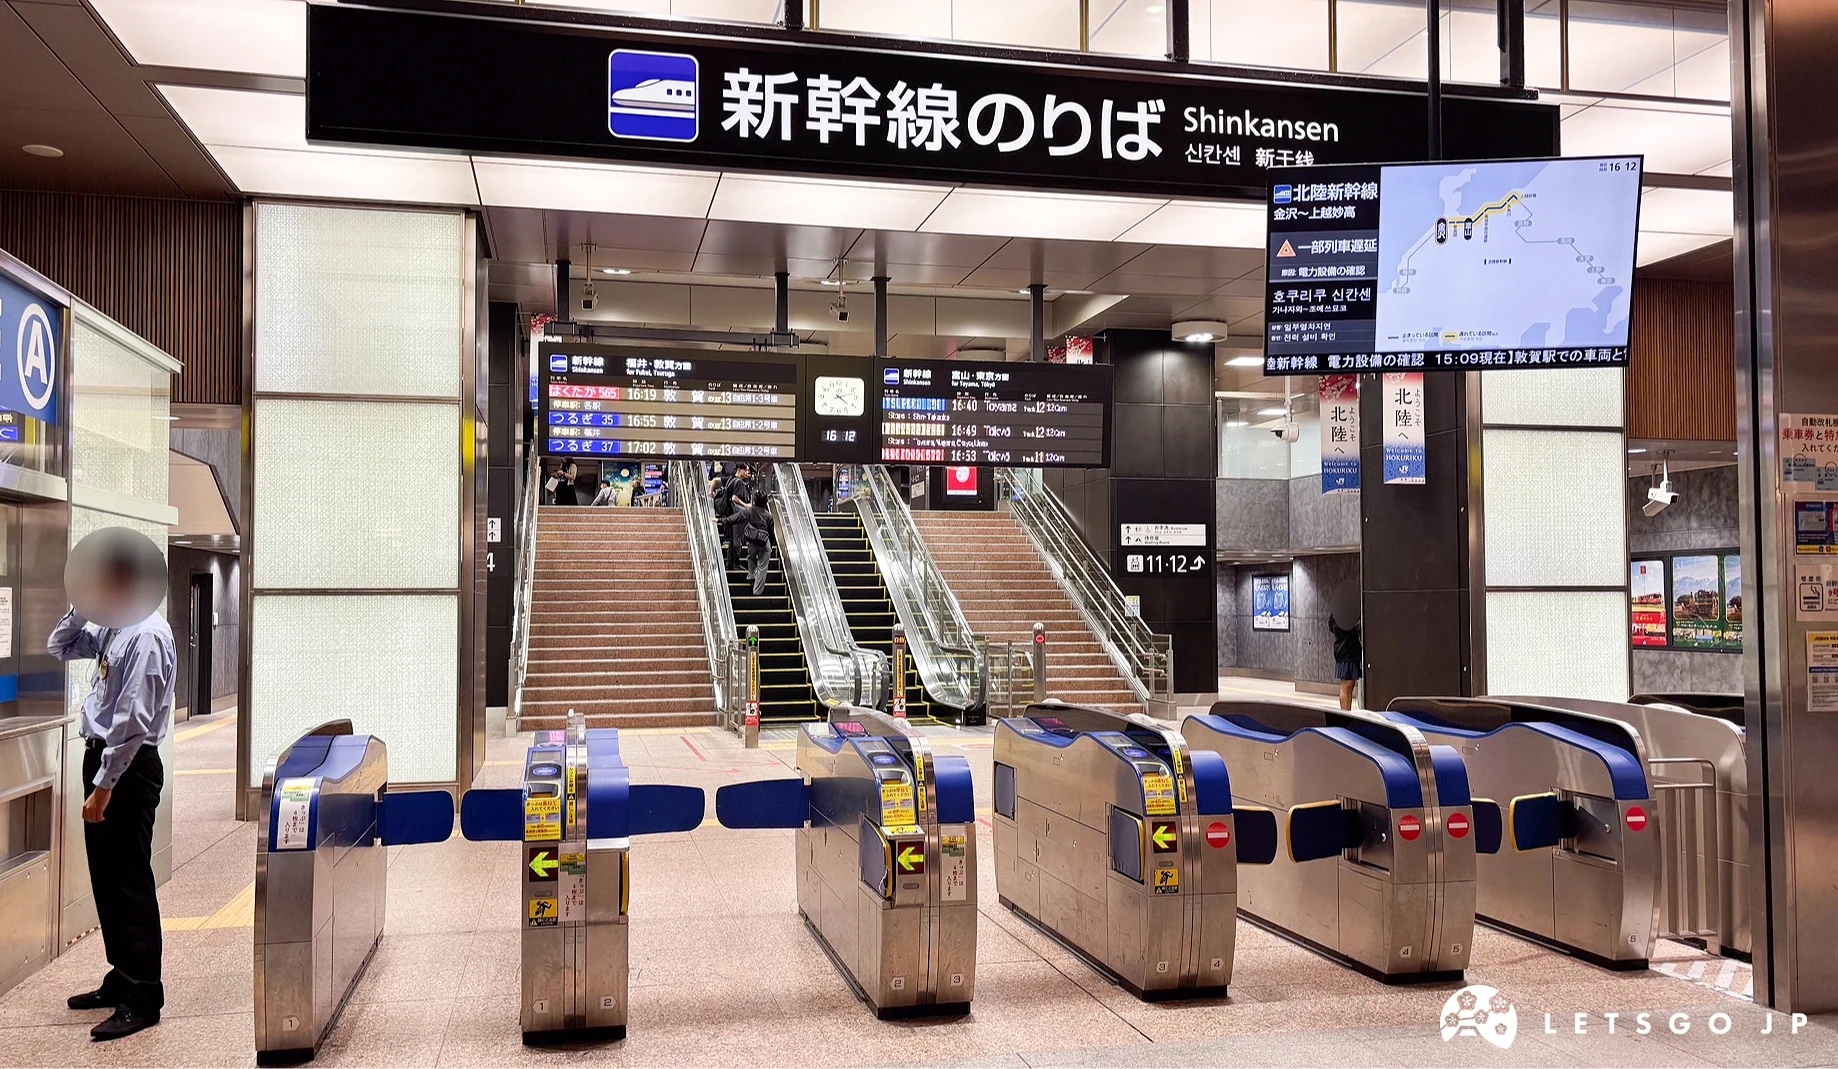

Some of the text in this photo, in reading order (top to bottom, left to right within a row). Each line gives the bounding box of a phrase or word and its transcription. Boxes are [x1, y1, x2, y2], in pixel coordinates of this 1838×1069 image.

[721, 67, 1165, 161] 新幹線のりば
[1184, 106, 1339, 142] Shinkansen
[1185, 143, 1241, 166] 신칸센
[1255, 147, 1315, 167] 新干线
[1610, 163, 1621, 171] 16
[1625, 162, 1637, 171] 12
[1293, 181, 1378, 202] 北陸新幹線
[1298, 238, 1378, 254] 一部列車遅延
[1299, 265, 1366, 278] 電力設備の確認
[1272, 287, 1371, 303] 호쿠리쿠 신칸센
[571, 355, 604, 367] 新幹線
[1327, 353, 1424, 369] 電力設備の確認
[1435, 347, 1627, 366] 15:09現在】敦賀駅での車両と
[903, 368, 932, 379] 新幹線
[549, 385, 596, 398] はくたか
[598, 387, 617, 399] 565
[627, 388, 657, 401] 16:19
[951, 399, 978, 411] 16:40
[1036, 401, 1046, 413] 12
[552, 413, 593, 425] つるぎ
[601, 414, 614, 425] 35
[627, 415, 657, 427] 16:55
[1394, 387, 1413, 440] 北陸へ
[1330, 405, 1348, 454] 北陸へ
[1348, 406, 1356, 442] ようこそ
[826, 430, 856, 442] 16 12
[951, 424, 977, 436] 16:49
[1035, 426, 1045, 438] 12
[1782, 428, 1838, 441] 乗車券と特
[552, 440, 592, 452] つるぎ
[601, 441, 613, 452] 37
[627, 442, 656, 454] 17:02
[951, 450, 977, 462] 16:53
[1386, 454, 1423, 462] HOKURIKU
[1453, 945, 1460, 953] 5
[1159, 963, 1166, 971] 3
[1213, 960, 1220, 968] 4
[894, 979, 902, 988] 2
[953, 975, 961, 983] 3
[540, 1003, 544, 1011] 1
[603, 998, 612, 1007] 2
[288, 1019, 294, 1028] 1
